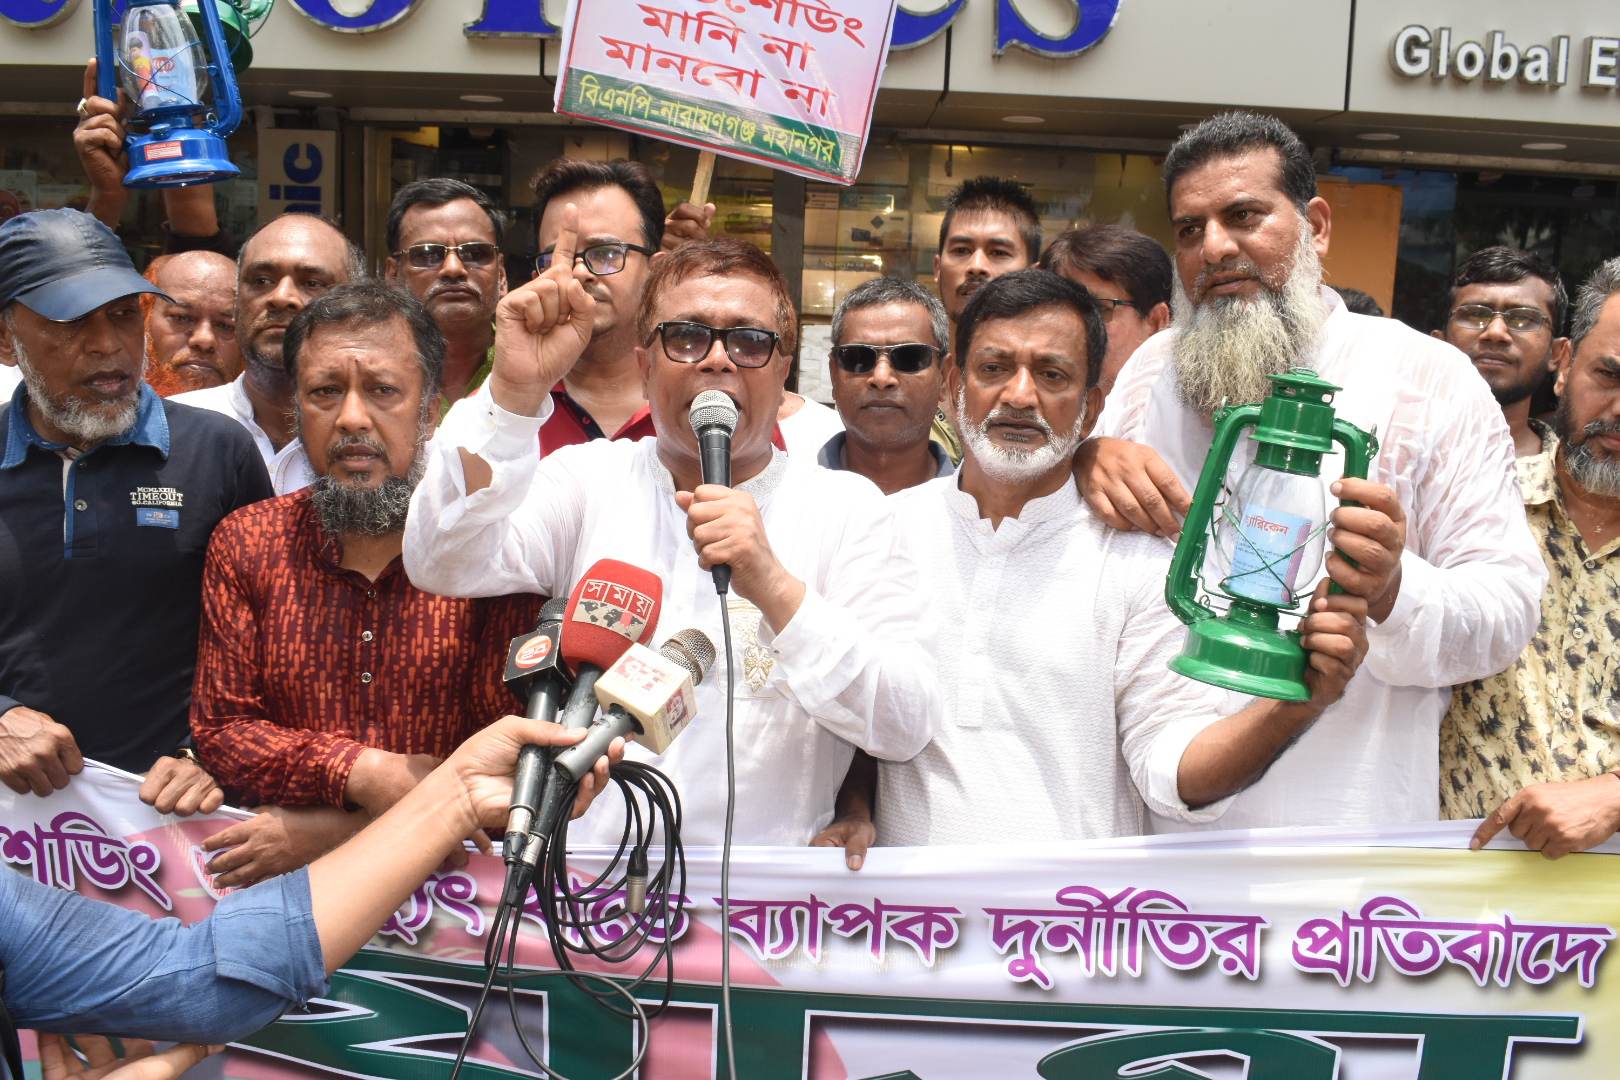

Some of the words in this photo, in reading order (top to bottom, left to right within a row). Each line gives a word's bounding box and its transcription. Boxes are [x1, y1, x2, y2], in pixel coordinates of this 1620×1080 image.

[637, 3, 746, 54] মানি
[759, 33, 817, 72] না
[1394, 24, 1570, 85] Global
[600, 36, 768, 99] মানবো
[780, 79, 837, 117] না
[269, 143, 323, 215] ic
[130, 492, 184, 501] TIMEOUT
[586, 581, 652, 618] সময়
[711, 893, 963, 966] ব্যাপক
[981, 885, 1268, 988] দুর্নীতির
[1292, 895, 1614, 985] প্রতিবাদে
